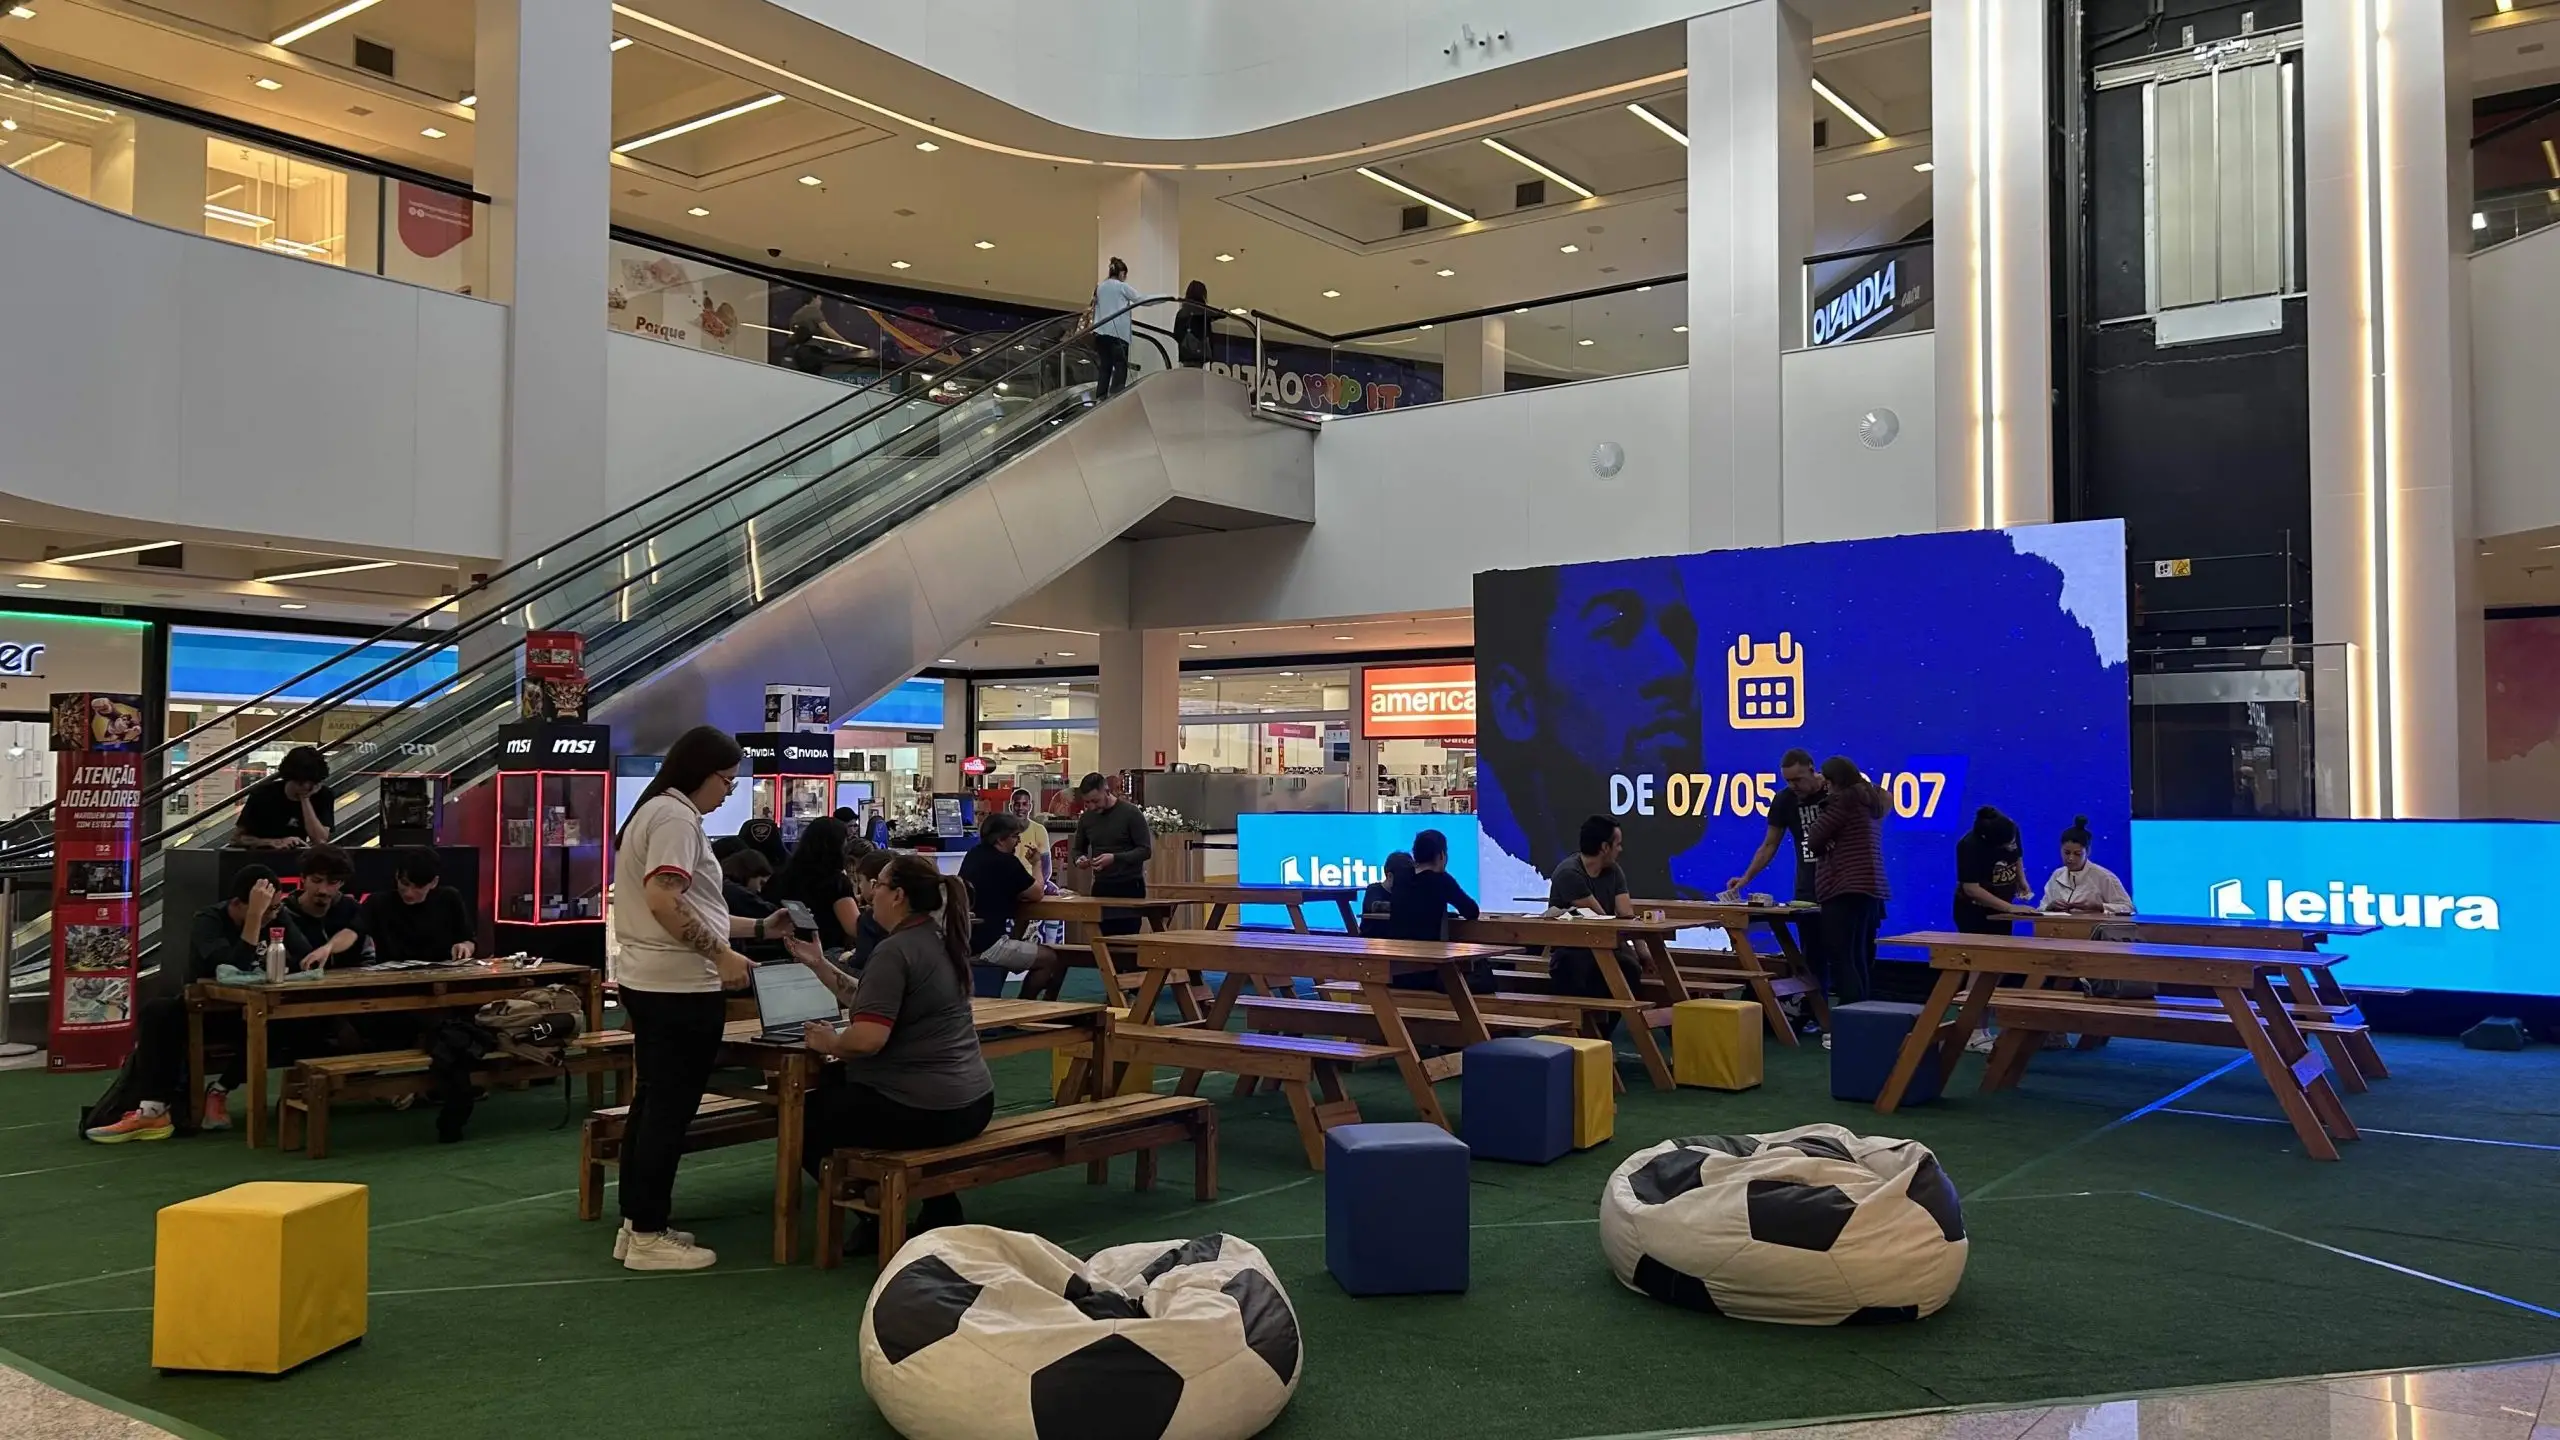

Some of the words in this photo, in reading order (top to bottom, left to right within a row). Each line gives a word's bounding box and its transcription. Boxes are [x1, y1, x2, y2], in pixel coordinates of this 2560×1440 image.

[636, 316, 686, 341] Porque
[1366, 382, 1402, 411] IT
[506, 739, 532, 754] msi
[552, 739, 596, 754] msi
[798, 749, 829, 758] NVIDIA
[72, 765, 137, 788] ATENÇÃO,
[1609, 774, 1655, 816] DE
[1666, 772, 1777, 818] 07/05
[2267, 879, 2500, 930] leitura
